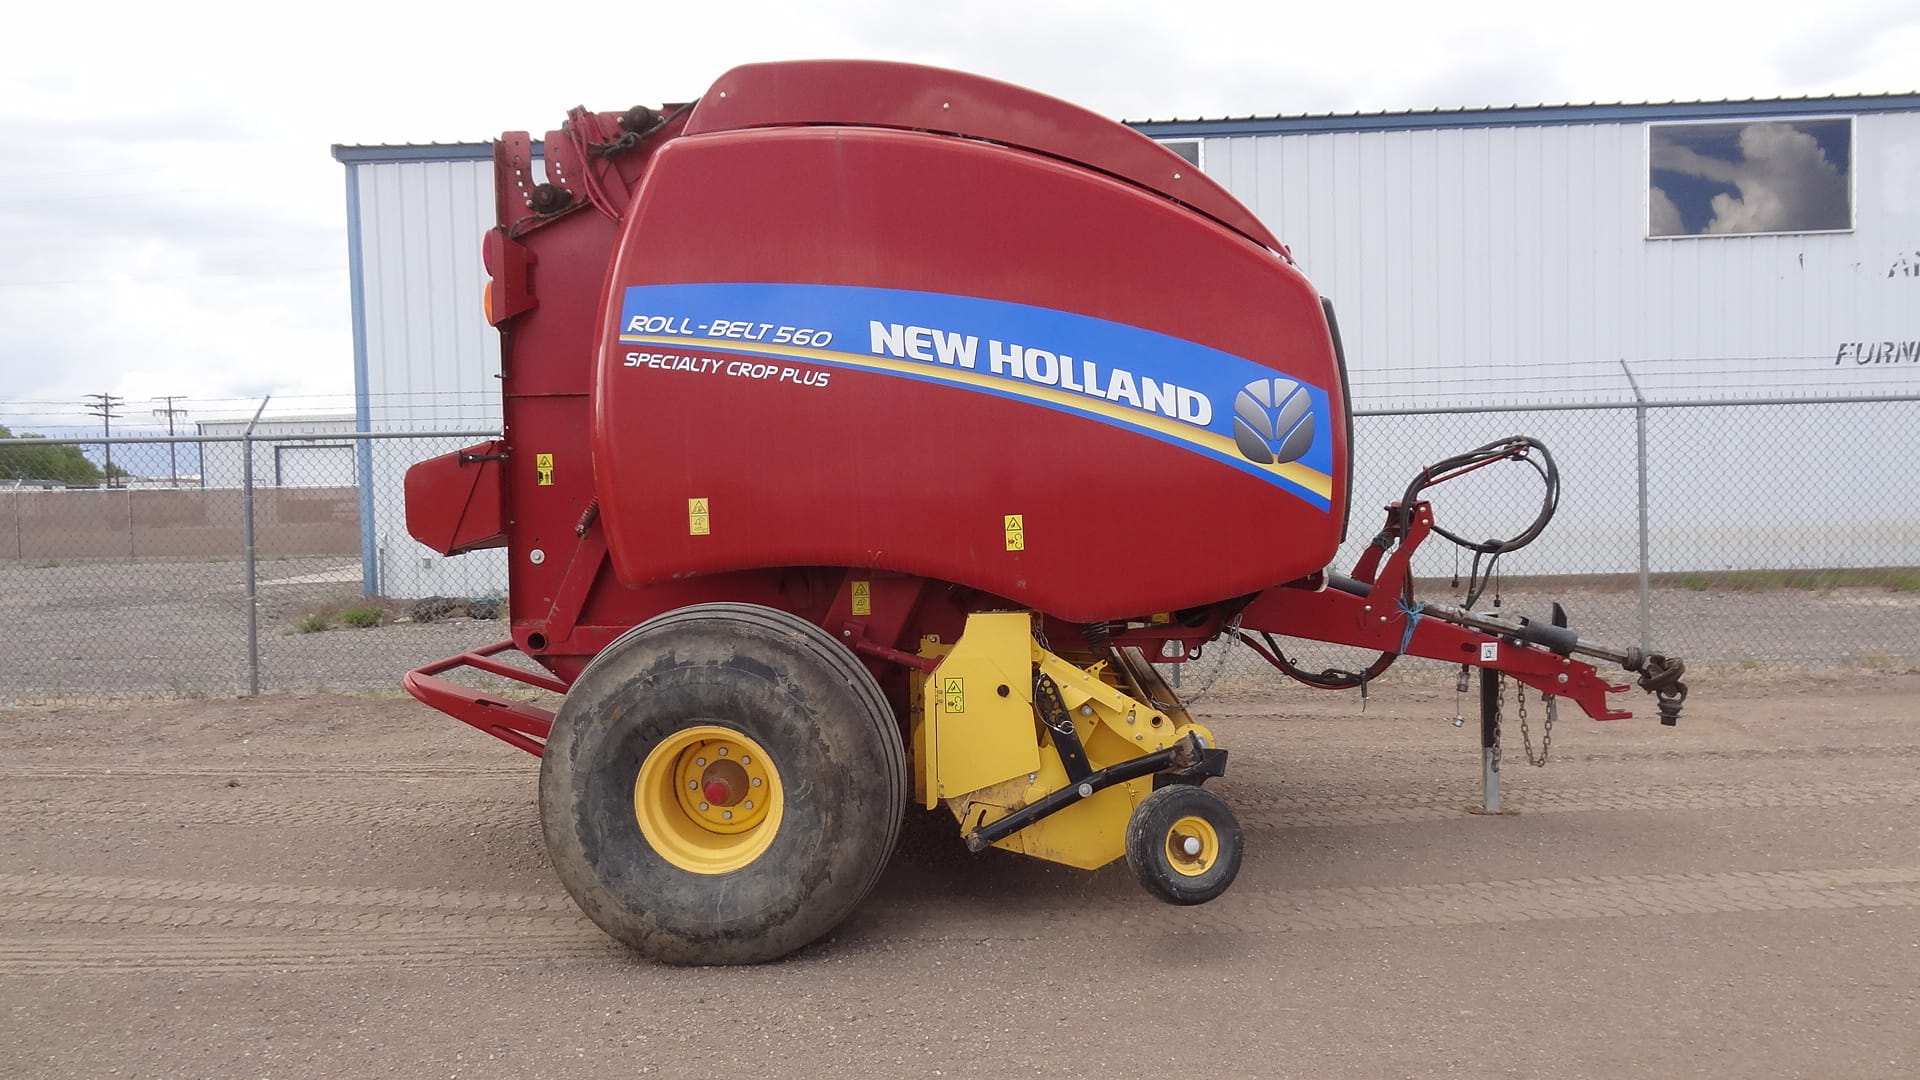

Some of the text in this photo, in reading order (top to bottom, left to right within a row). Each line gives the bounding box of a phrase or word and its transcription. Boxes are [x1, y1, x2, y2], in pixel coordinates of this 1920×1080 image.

[773, 328, 833, 348] 560
[624, 352, 831, 388] SPECIALTY CROP PLUS
[870, 320, 1213, 426] NEW HOLLAND
